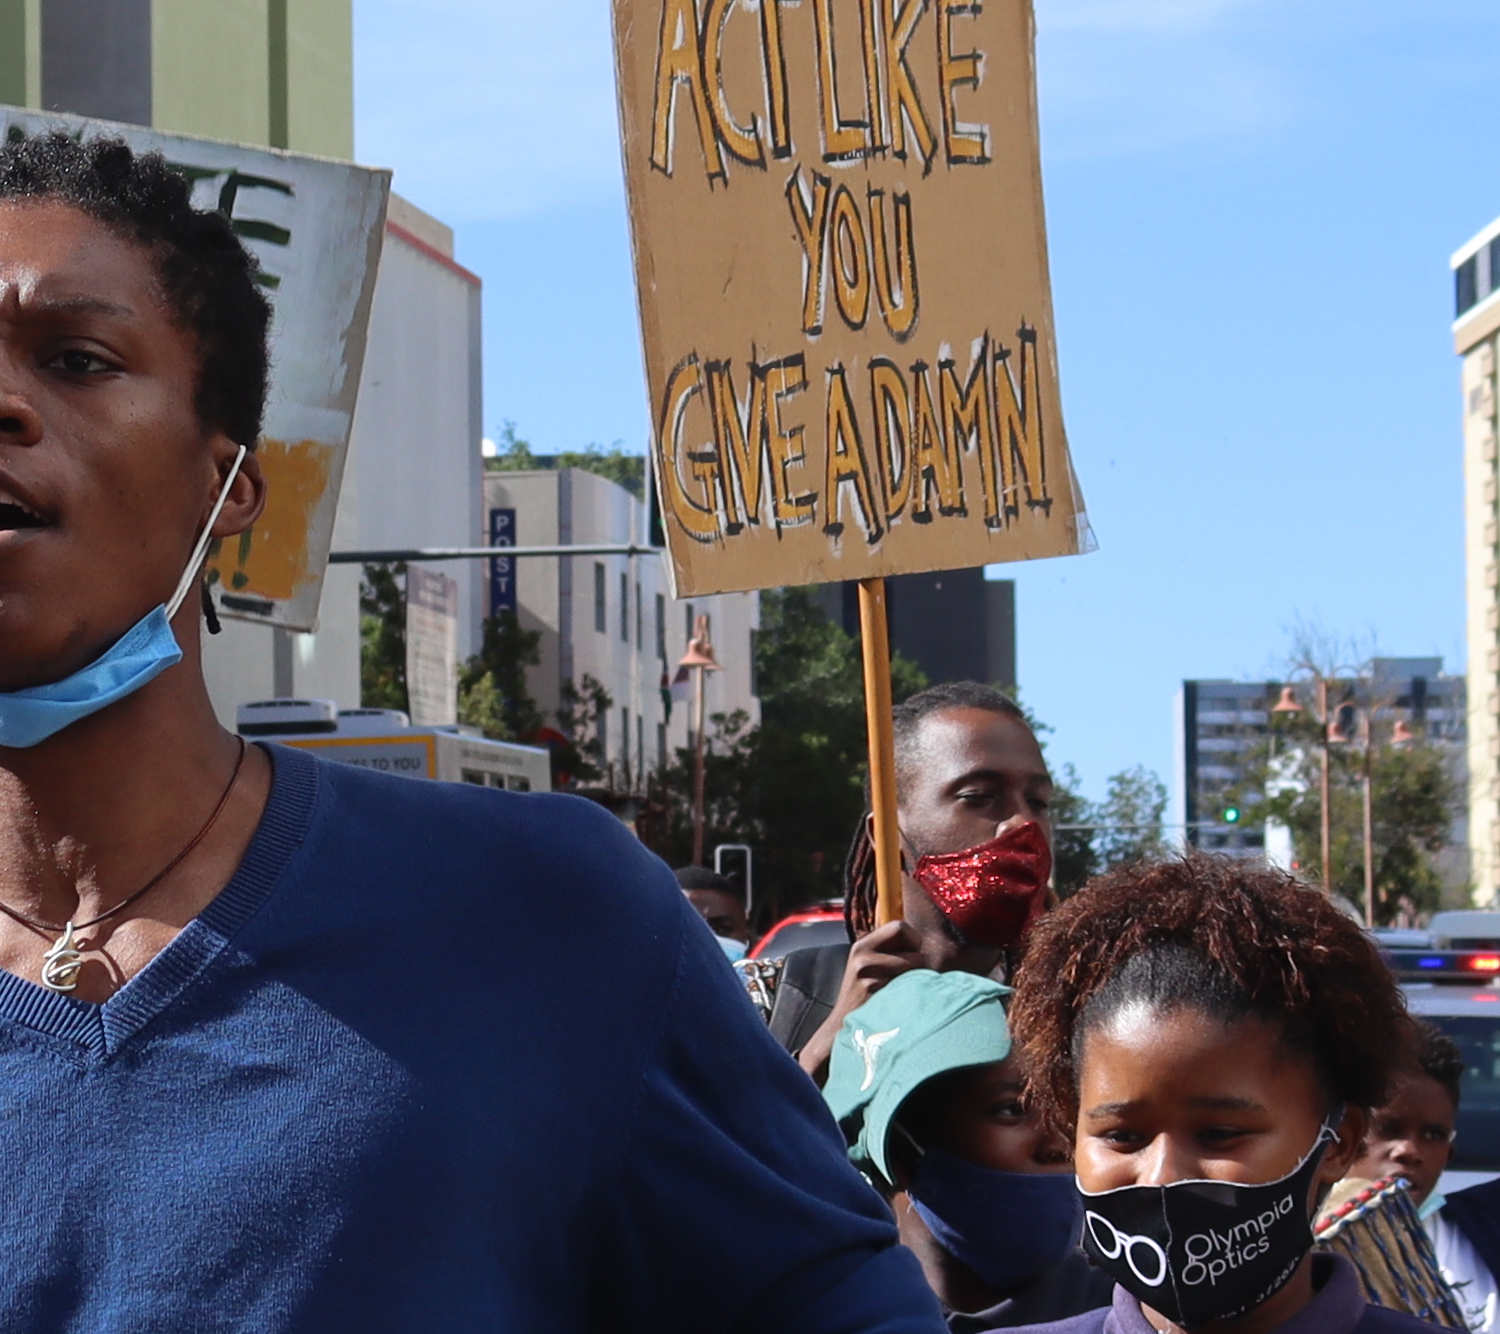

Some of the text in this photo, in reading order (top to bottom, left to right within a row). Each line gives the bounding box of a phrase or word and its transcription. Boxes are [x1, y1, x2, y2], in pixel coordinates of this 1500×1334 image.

[785, 163, 920, 342] YOU
[660, 319, 1054, 545] GIVE A DAMN
[1181, 1235, 1270, 1286] Optics
[1184, 1193, 1294, 1260] Olympia
